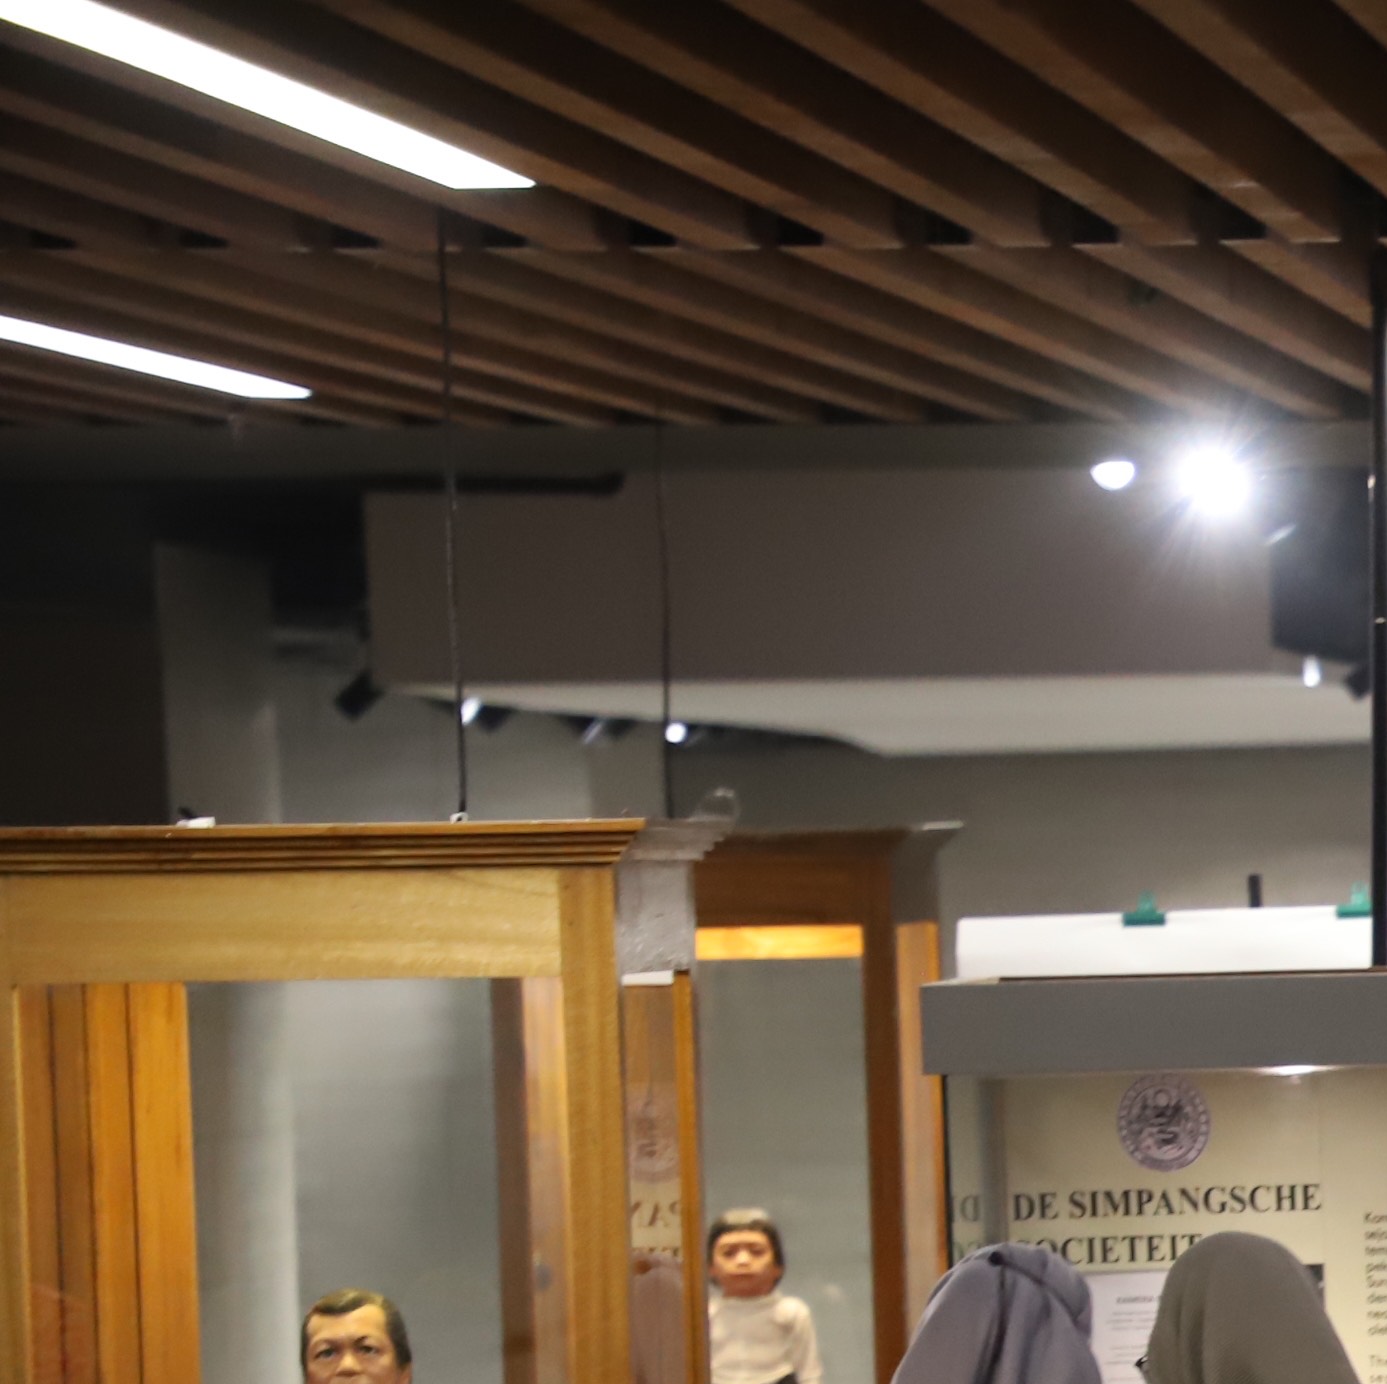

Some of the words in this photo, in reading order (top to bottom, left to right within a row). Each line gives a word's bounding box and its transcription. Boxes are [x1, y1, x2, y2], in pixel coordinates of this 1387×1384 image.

[1013, 1191, 1060, 1222] DE
[1068, 1183, 1323, 1220] SIMPANGSCHE
[1016, 1233, 1202, 1266] CIETEIT
